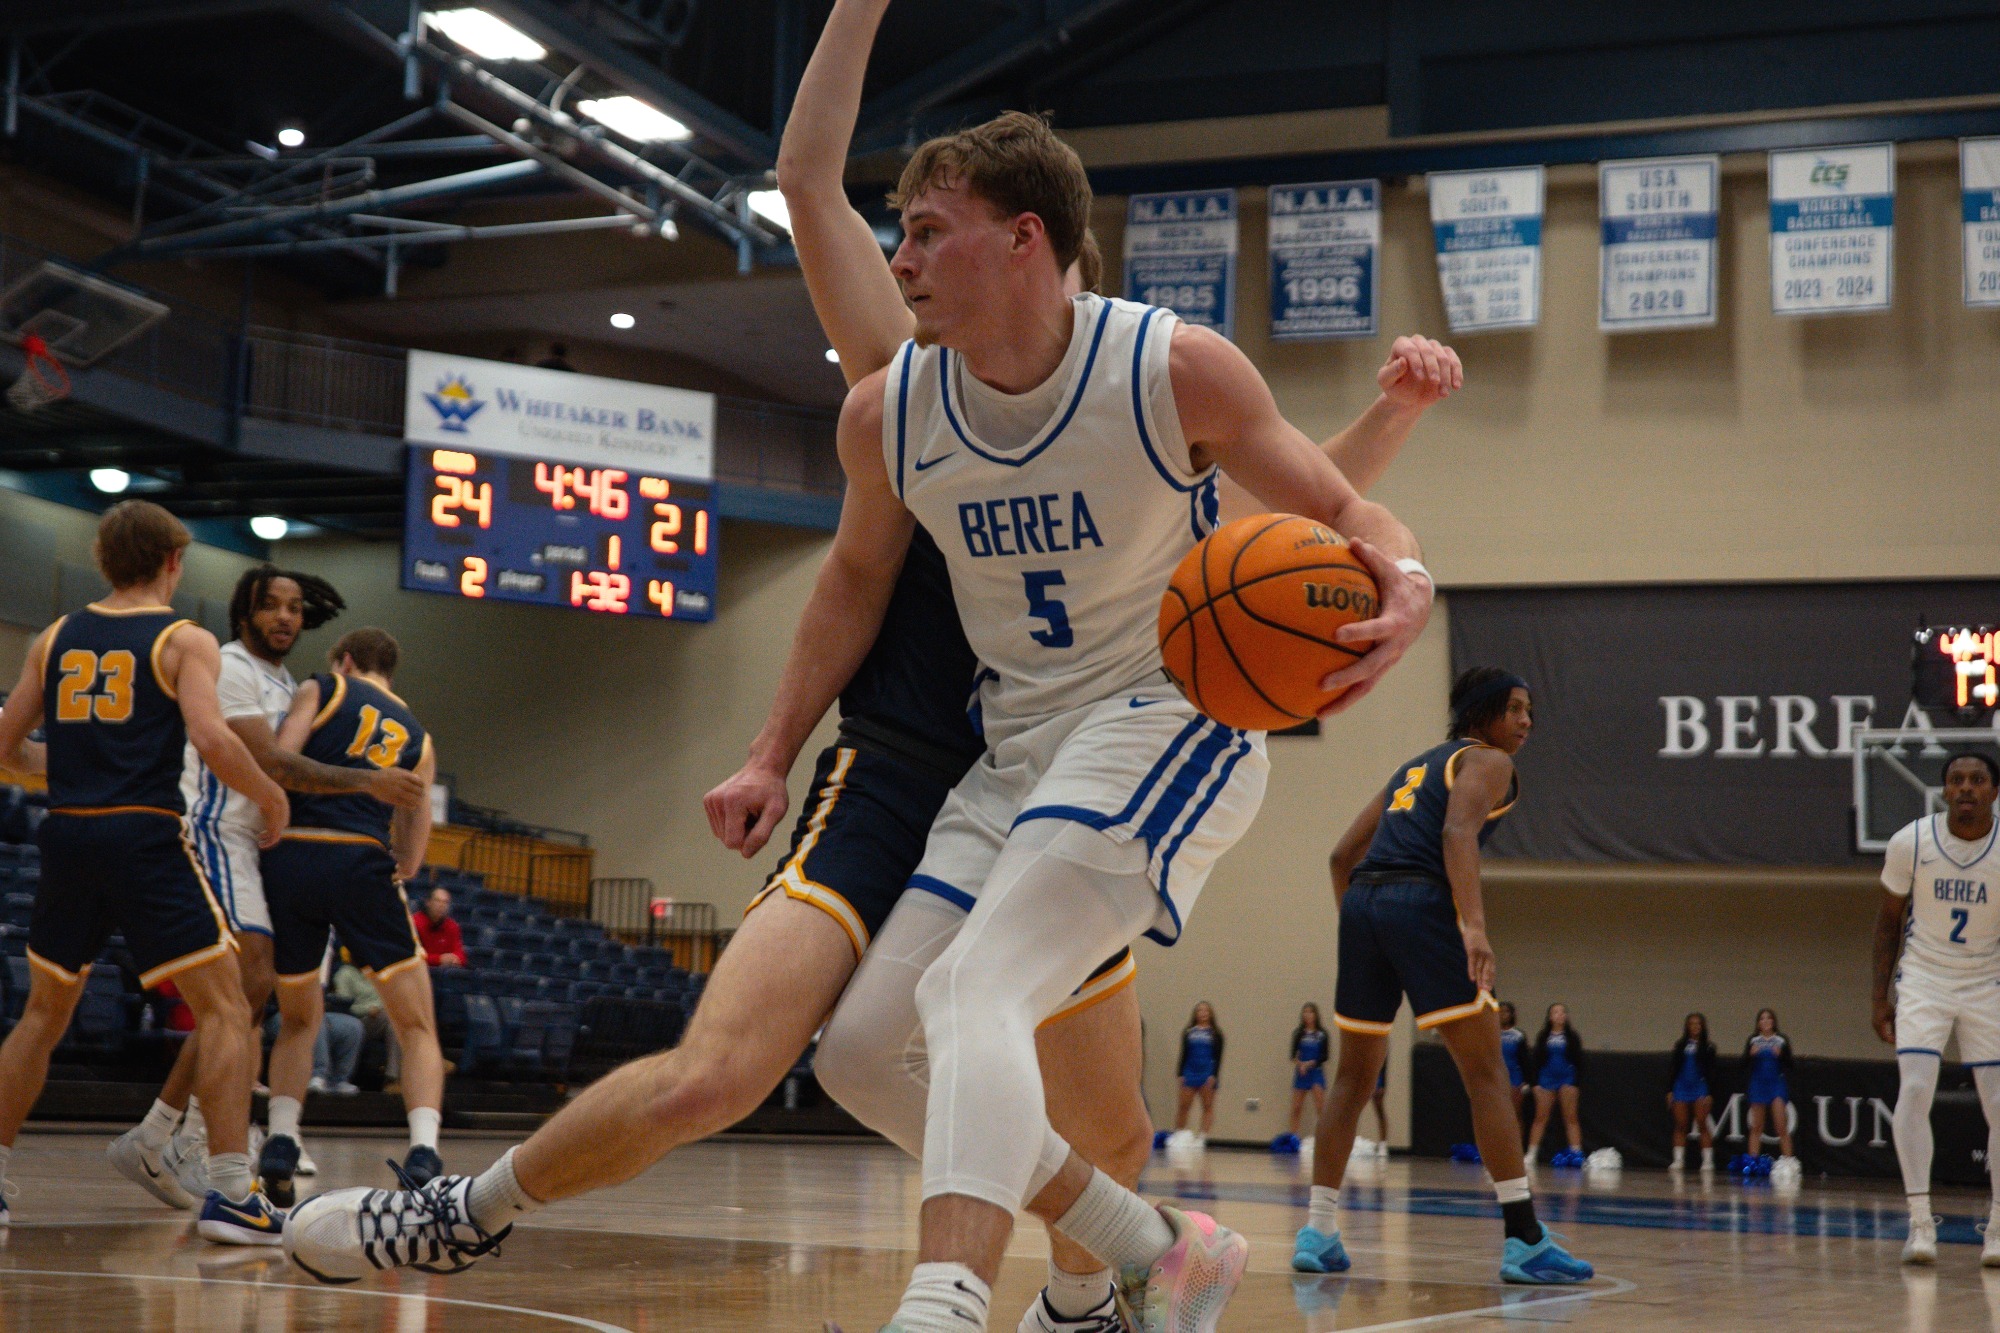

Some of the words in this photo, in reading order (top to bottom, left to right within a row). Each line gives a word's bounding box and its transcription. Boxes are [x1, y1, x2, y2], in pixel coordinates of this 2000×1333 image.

[1639, 168, 1677, 187] USA
[1626, 190, 1691, 210] SOUTH
[1786, 212, 1874, 230] BASKETBALL
[1785, 233, 1876, 251] CONFERENCE
[1789, 251, 1872, 268] CHAMPIONS
[1284, 277, 1360, 304] 1996
[1617, 267, 1696, 283] CHAMPIONS
[1785, 278, 1822, 299] 2023
[1836, 275, 1874, 297] 2024
[1142, 285, 1215, 308] 1985
[1629, 290, 1685, 311] 2020
[431, 474, 493, 530] 24
[535, 462, 630, 521] 4:46
[650, 502, 709, 556] 21
[957, 490, 1105, 558] BEREA
[608, 534, 621, 571] 1
[461, 556, 488, 598] 2
[648, 579, 674, 617] 4
[1021, 569, 1074, 649] 5
[56, 648, 137, 722] 23
[345, 703, 411, 769] 13
[1657, 695, 1949, 760] BEREA
[1386, 762, 1428, 812] 2
[1934, 878, 1988, 904] BEREA
[1948, 907, 1969, 944] 2
